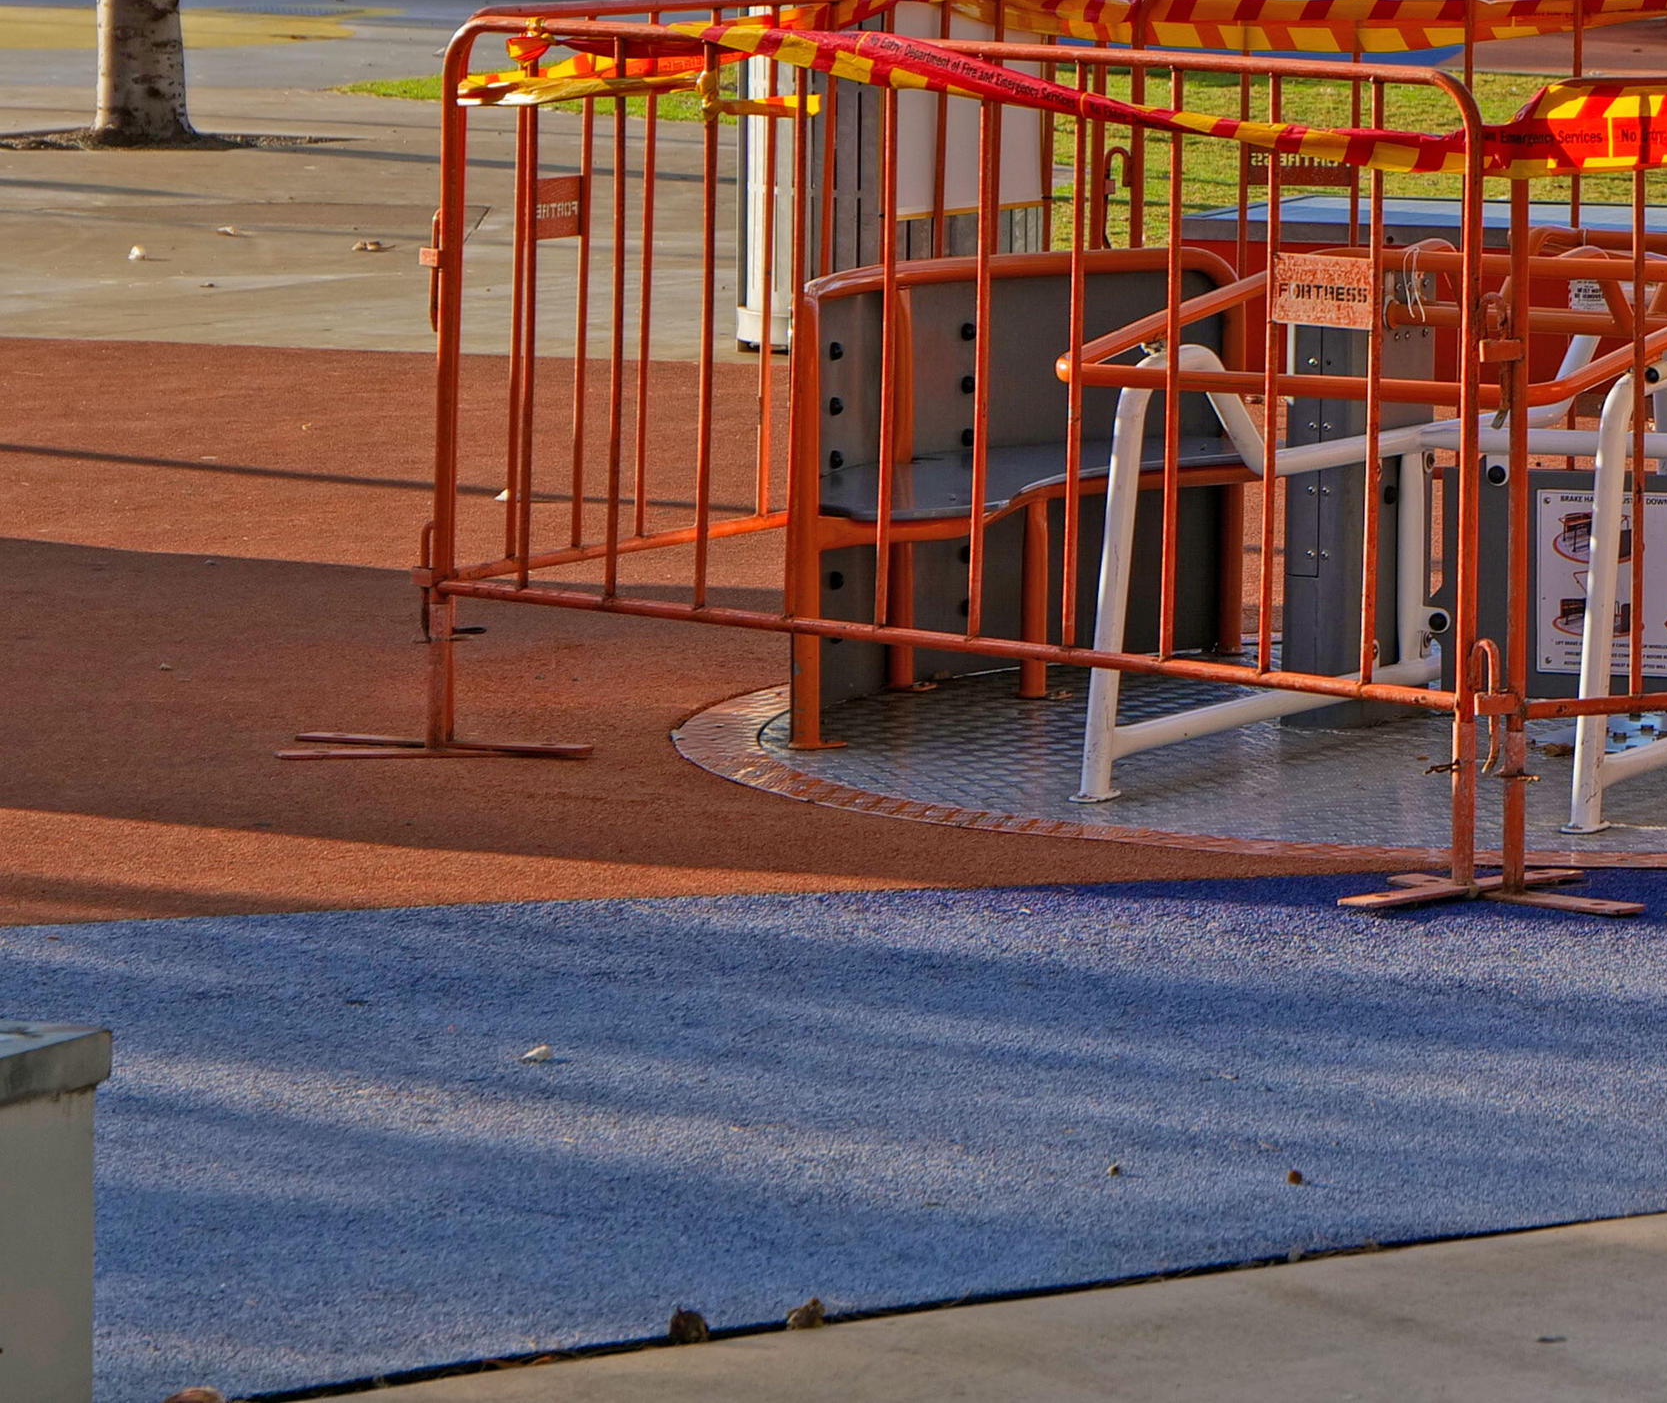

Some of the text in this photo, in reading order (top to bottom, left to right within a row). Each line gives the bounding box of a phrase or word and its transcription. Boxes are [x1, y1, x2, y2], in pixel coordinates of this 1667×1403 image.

[1558, 129, 1603, 145] Services
[1621, 128, 1637, 143] No
[1278, 281, 1368, 304] FORTRESS
[1560, 494, 1583, 503] BRAKE
